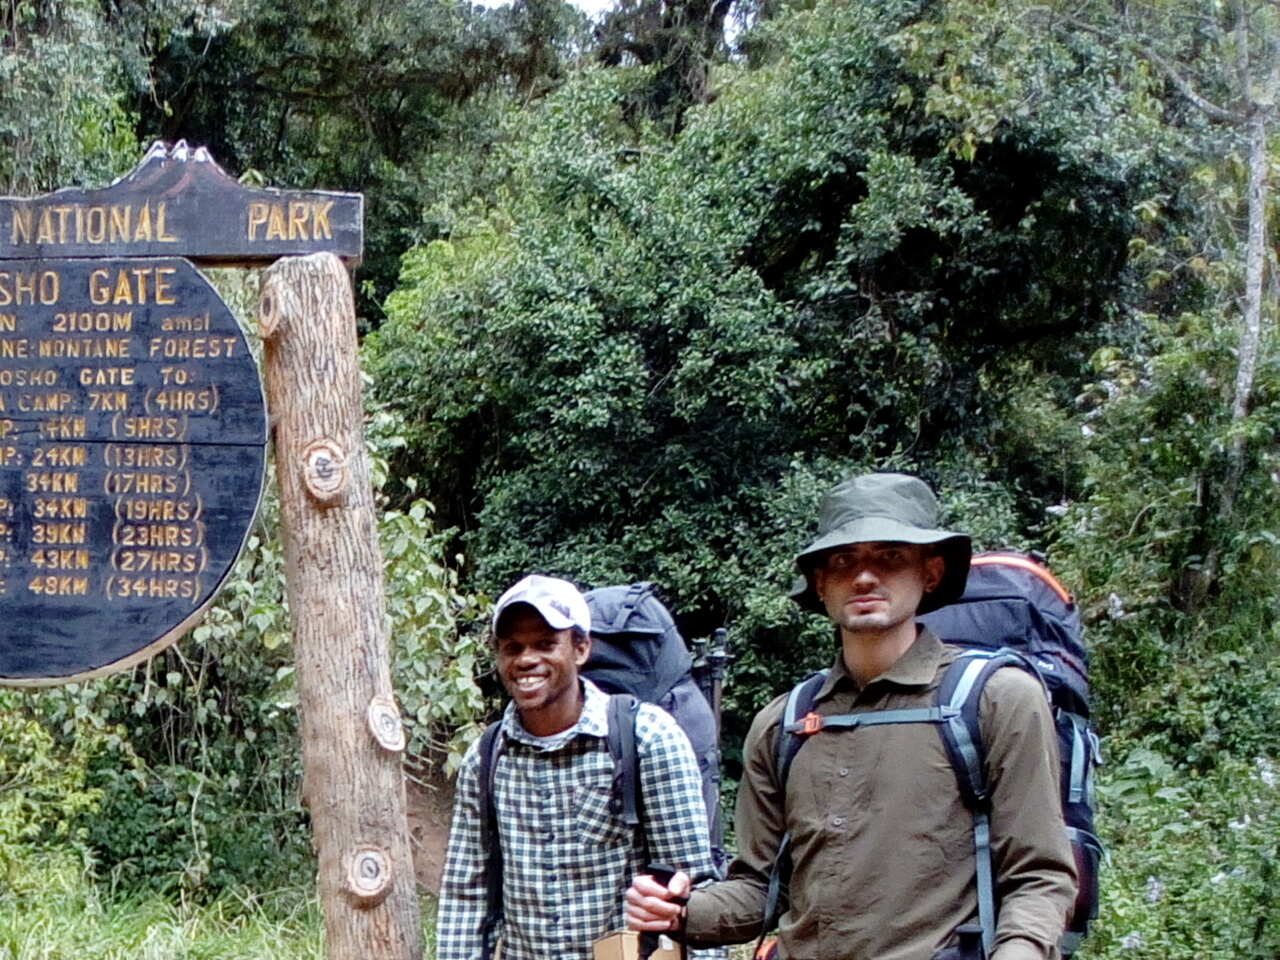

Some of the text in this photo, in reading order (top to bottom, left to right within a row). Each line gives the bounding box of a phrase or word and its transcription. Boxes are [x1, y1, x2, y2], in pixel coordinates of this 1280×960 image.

[11, 200, 178, 245] NATIONAL
[247, 200, 335, 242] PARK
[90, 268, 176, 305] GATE
[53, 311, 133, 332] 2100M
[161, 312, 210, 331] amsl
[40, 338, 131, 358] MONTANE
[150, 337, 237, 358] FOREST
[80, 368, 134, 385] GATE
[89, 391, 128, 411] 7KM
[144, 384, 220, 414] (4HRS)
[32, 446, 86, 466] 24KM
[104, 443, 189, 471] (13HRS)
[27, 472, 78, 492] 34KM
[104, 470, 191, 497] (17HRS)
[34, 497, 87, 518] 34KM
[115, 493, 202, 522] (19HRS)
[112, 520, 204, 547] (23HRS)
[31, 549, 89, 570] 43KM
[111, 547, 208, 574] (27HRS)
[106, 576, 202, 604] (34HRS)
